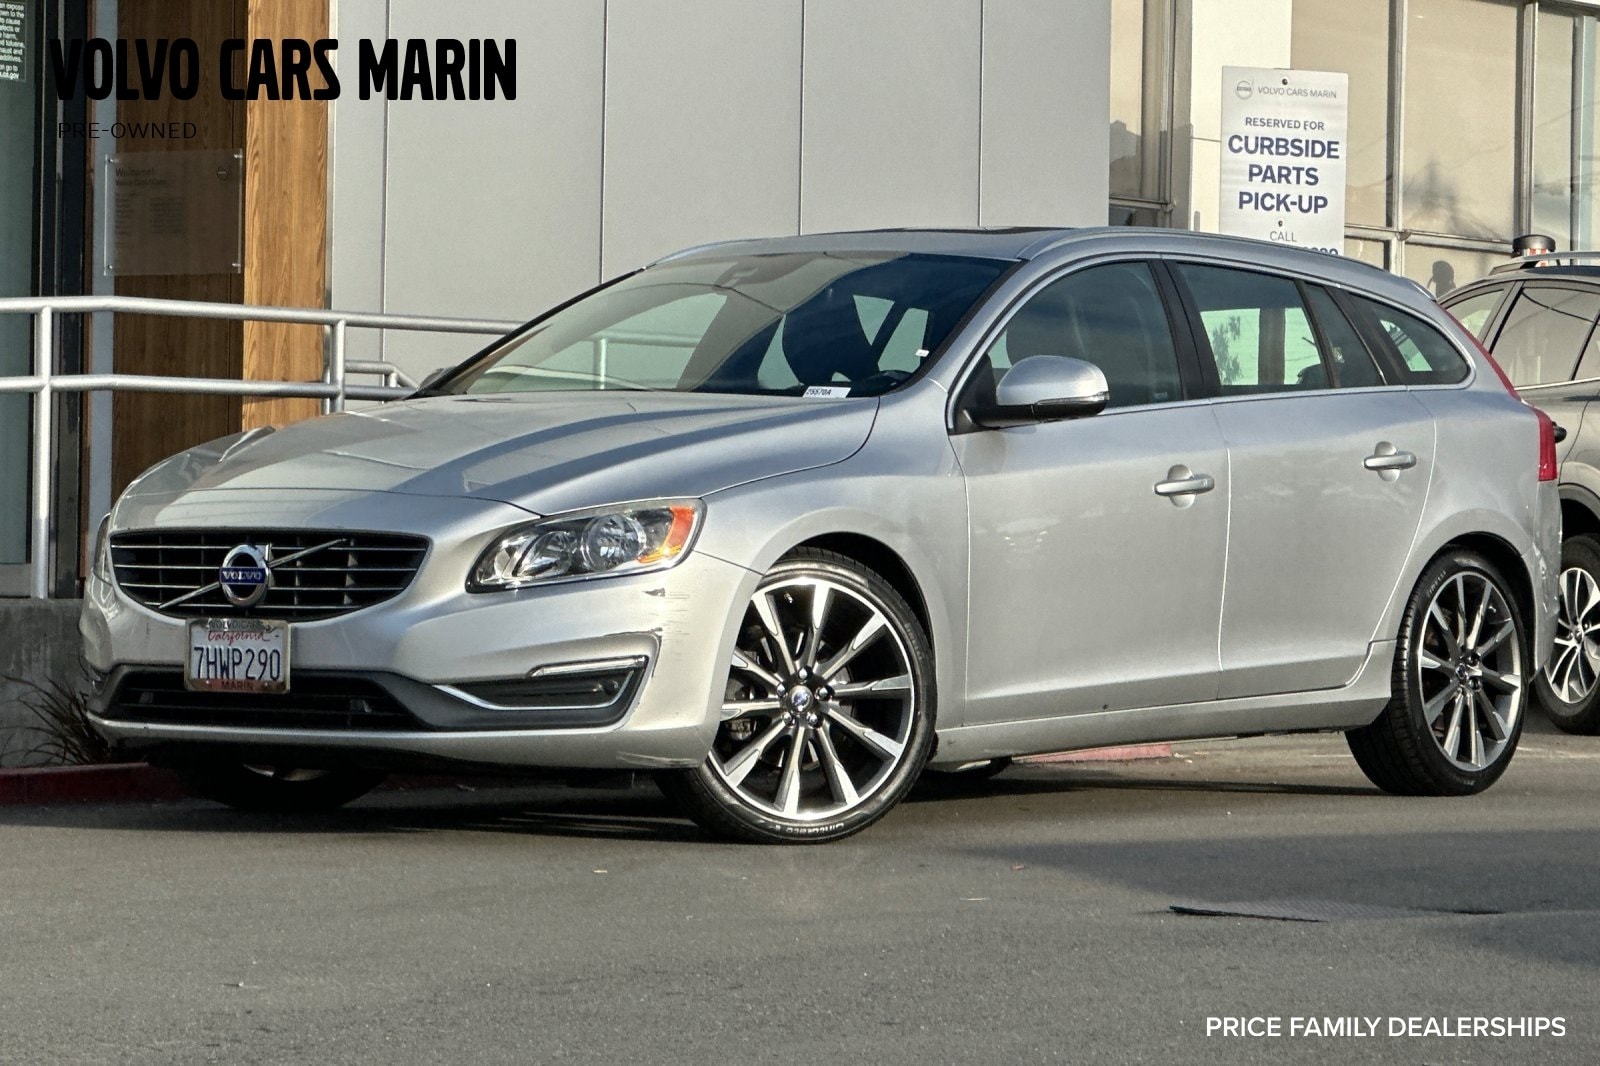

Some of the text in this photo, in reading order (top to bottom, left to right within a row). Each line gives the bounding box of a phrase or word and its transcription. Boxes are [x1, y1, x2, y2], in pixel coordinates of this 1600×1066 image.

[1258, 87, 1285, 96] VOLVO
[1286, 88, 1309, 97] CARS
[1310, 90, 1337, 99] MARIN
[1245, 117, 1325, 131] RESERVED FOR
[1228, 134, 1340, 159] CURBSIDE
[1248, 164, 1319, 186] PARTS
[1239, 191, 1328, 214] PICK-UP
[1269, 231, 1297, 242] CALL
[222, 570, 262, 581] VOLVO
[194, 645, 281, 682] 7HWP290
[221, 681, 254, 691] MARIN
